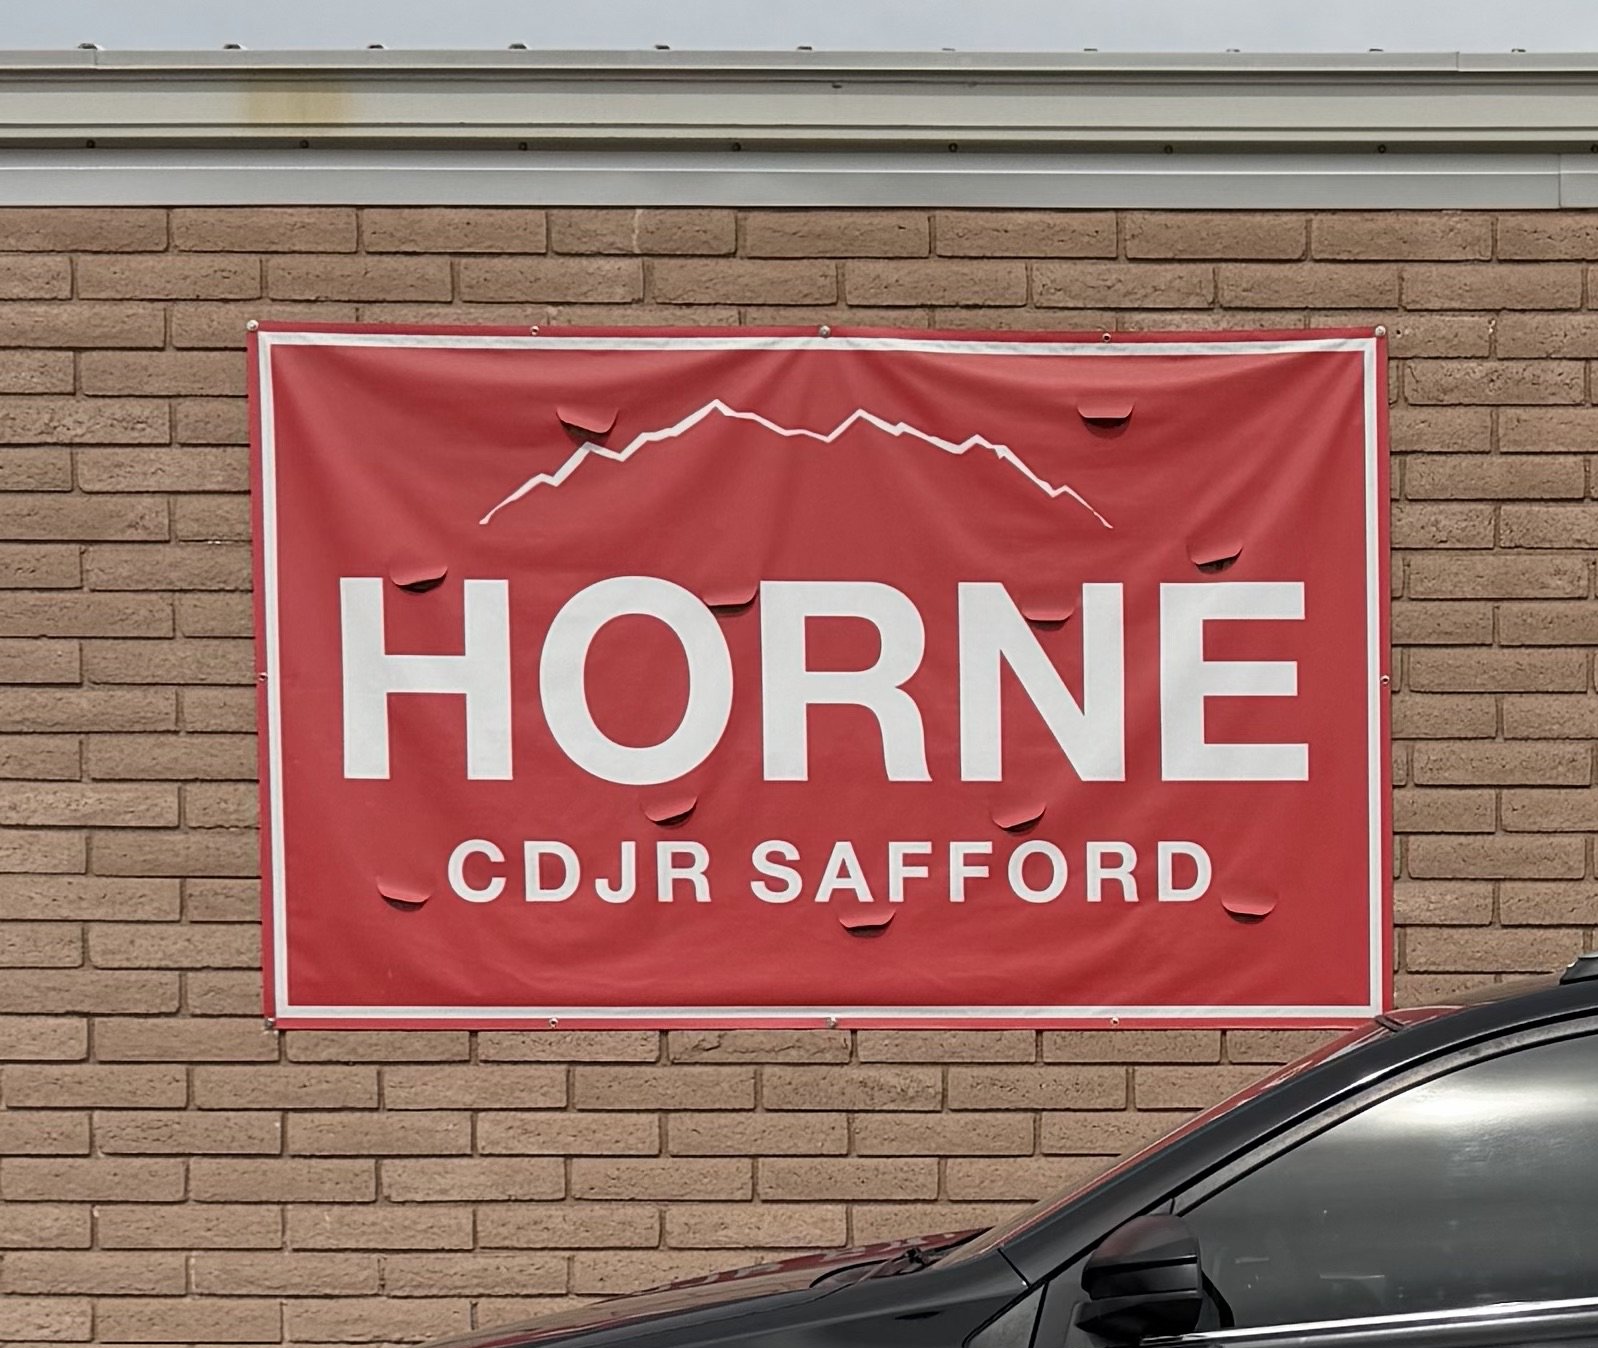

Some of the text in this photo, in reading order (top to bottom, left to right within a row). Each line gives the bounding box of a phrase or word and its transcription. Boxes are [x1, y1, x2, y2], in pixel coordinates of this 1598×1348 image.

[339, 575, 1310, 786] HORNE
[447, 839, 1213, 904] CDJR SAFFORD
